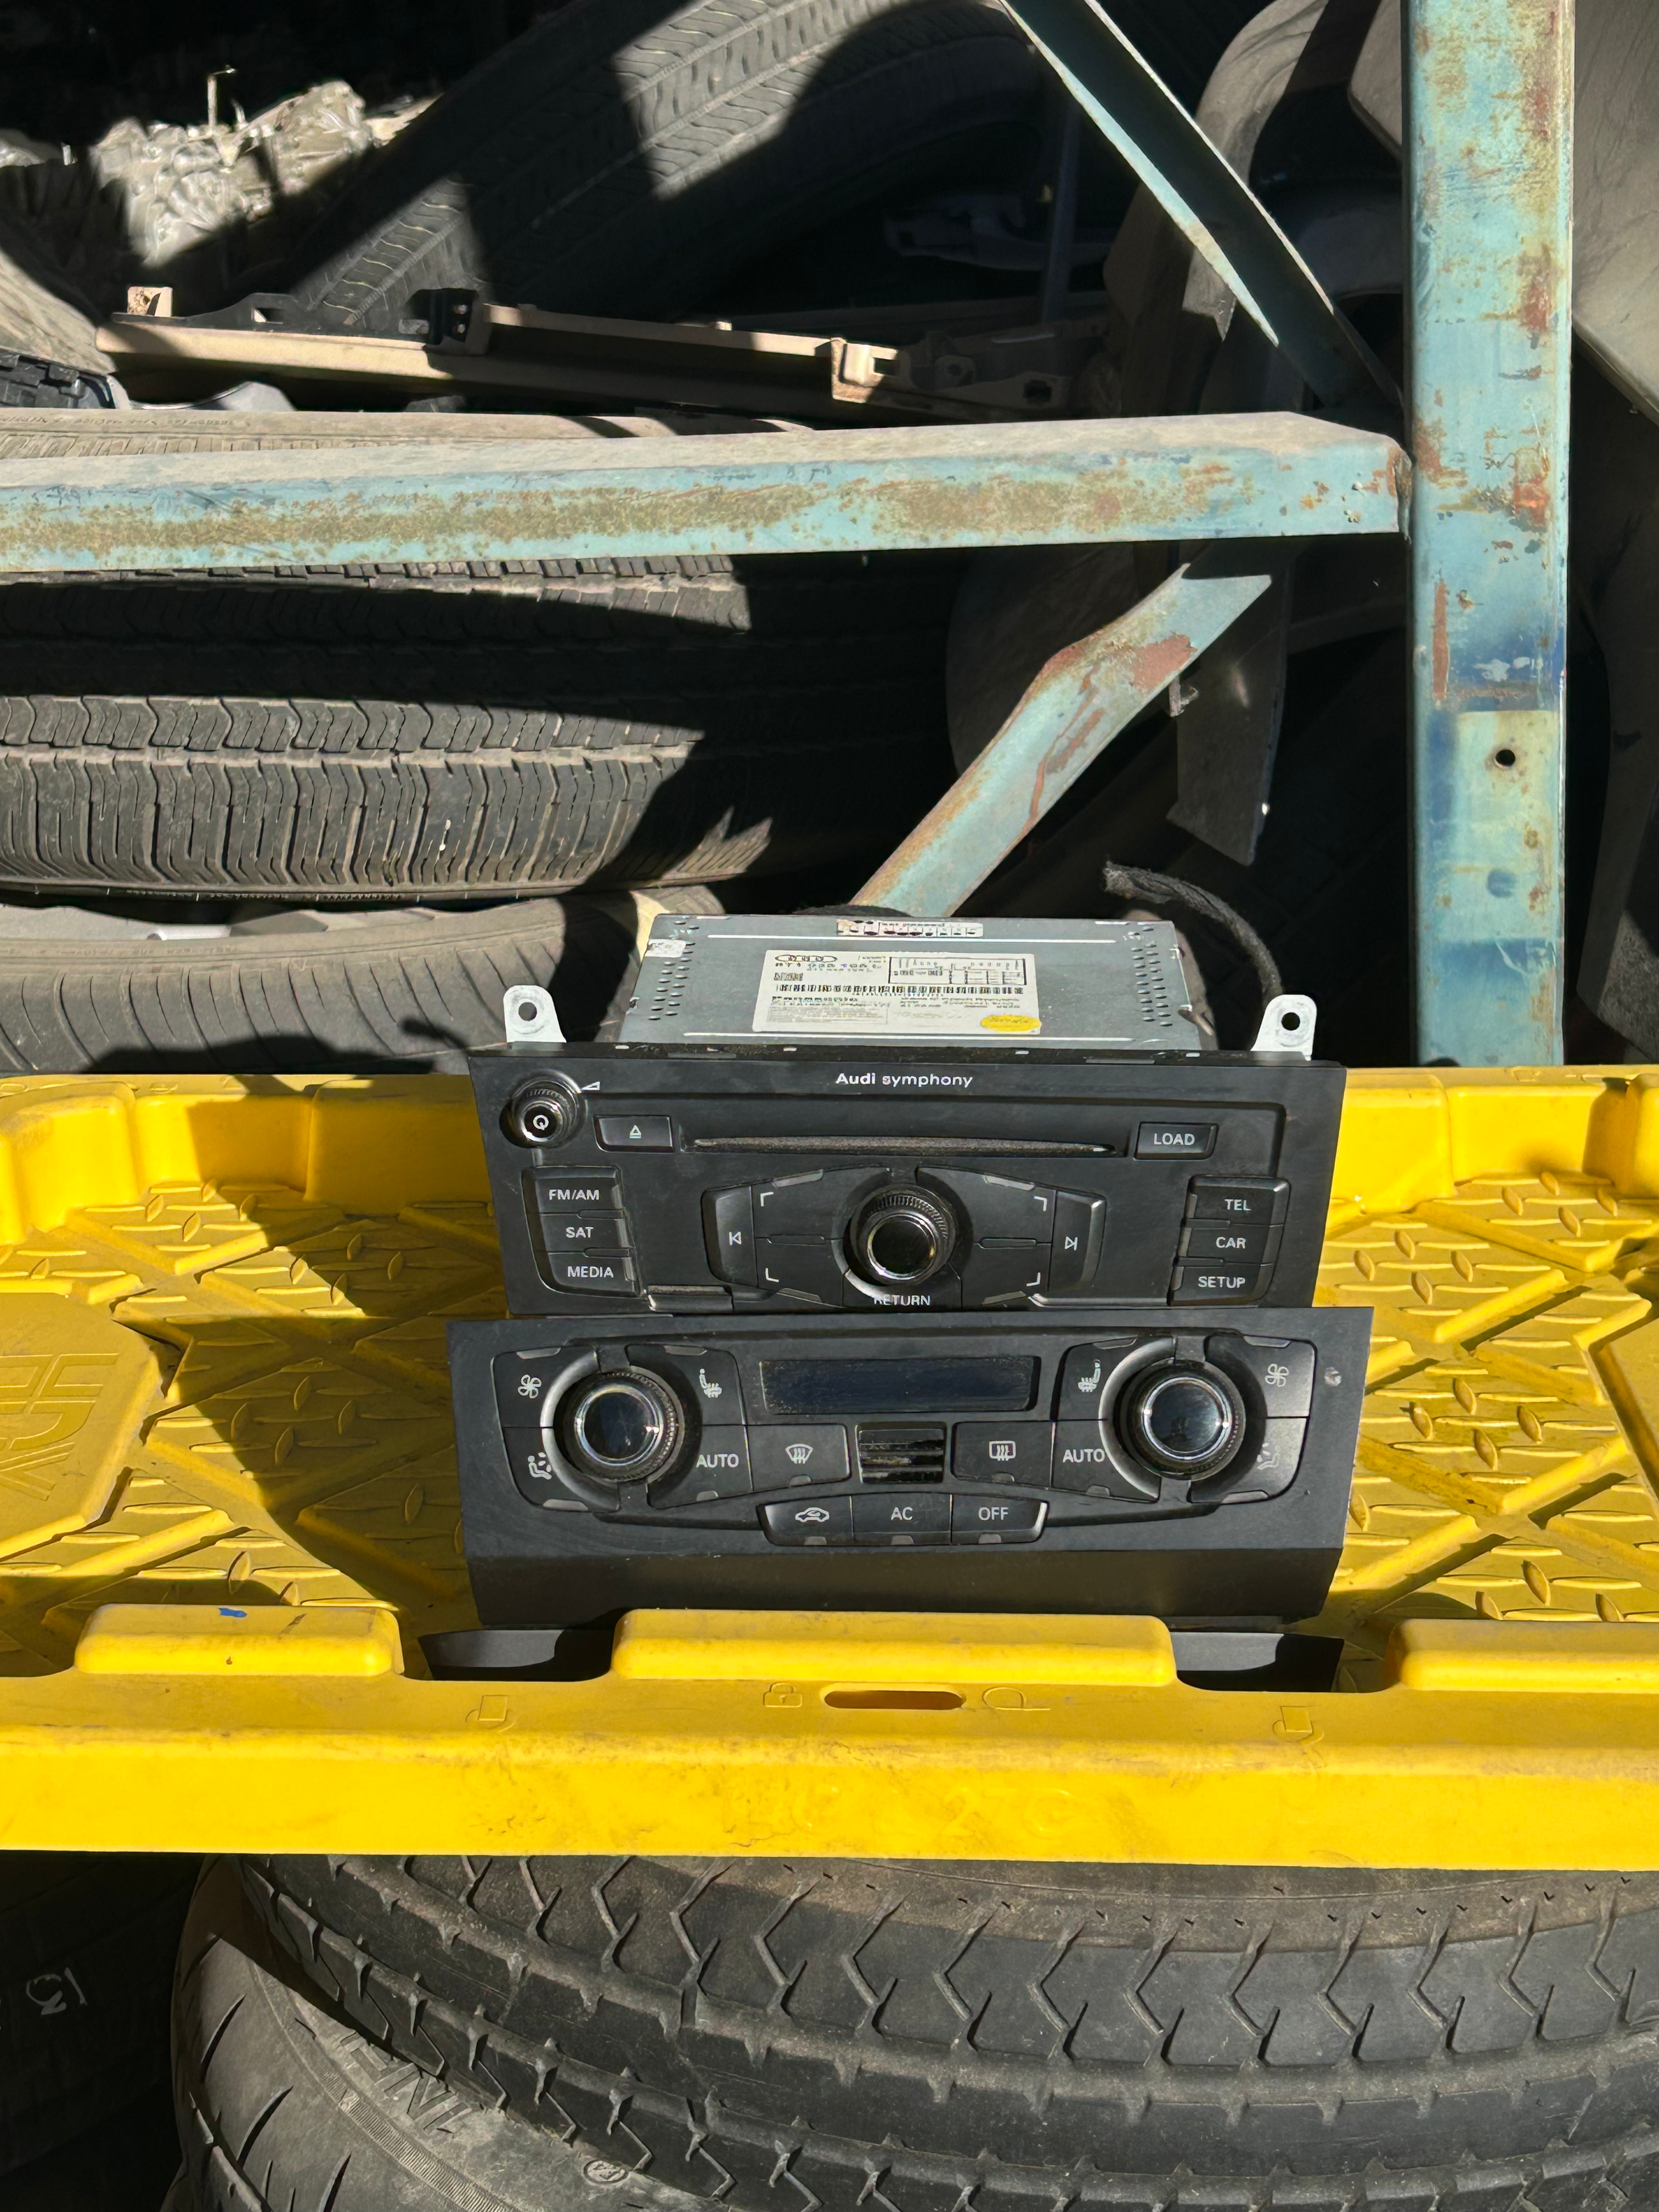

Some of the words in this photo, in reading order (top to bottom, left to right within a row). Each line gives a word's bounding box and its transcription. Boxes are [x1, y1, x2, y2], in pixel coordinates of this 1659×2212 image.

[836, 1073, 876, 1085] Audi
[882, 1073, 973, 1088] symphony
[1153, 1133, 1195, 1146] LOAD
[549, 1189, 600, 1201] FM/AM
[1224, 1199, 1251, 1211] TEL
[566, 1226, 594, 1239] SAT
[1216, 1236, 1246, 1249] CAR
[567, 1266, 614, 1279] MEDIA
[1198, 1276, 1246, 1289] SETUP
[696, 1453, 739, 1468] AUTO
[1062, 1448, 1105, 1463] AUTO
[890, 1506, 913, 1521] AC
[978, 1506, 1009, 1521] OFF
